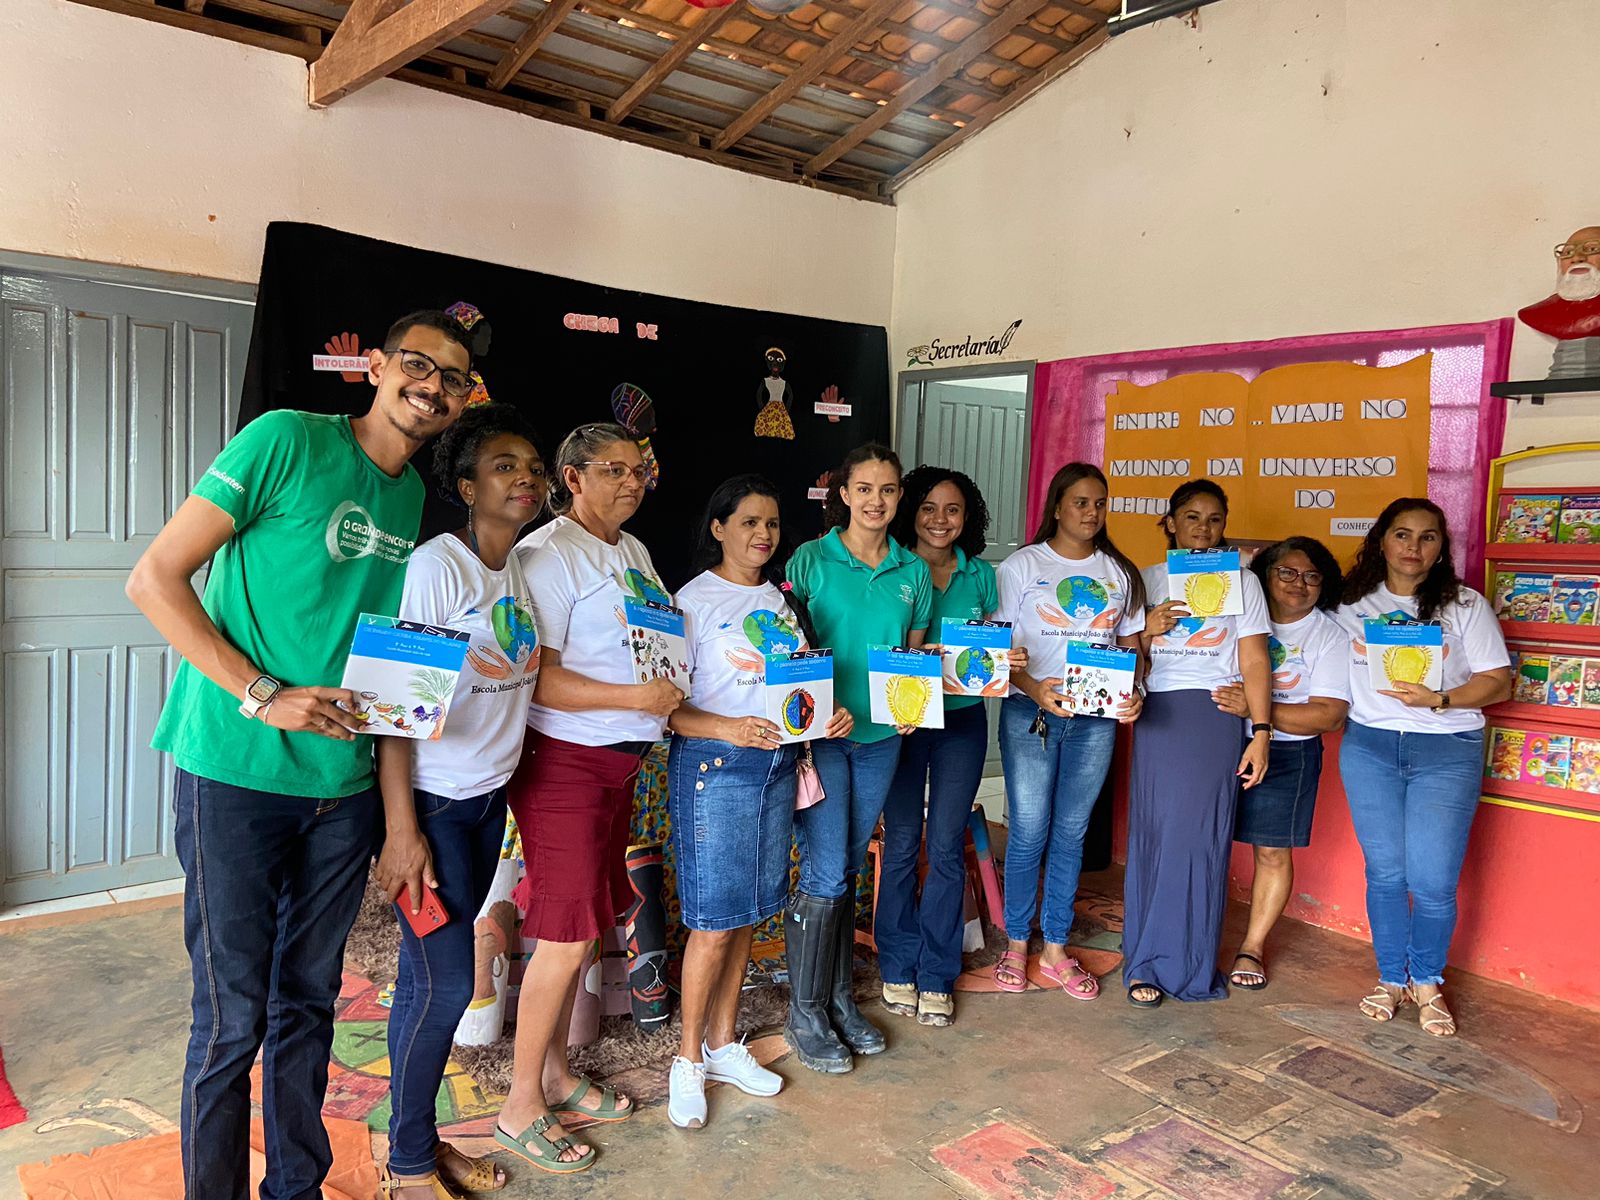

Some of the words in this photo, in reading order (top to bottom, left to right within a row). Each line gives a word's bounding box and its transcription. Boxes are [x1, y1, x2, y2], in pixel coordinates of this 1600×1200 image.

[563, 313, 620, 334] CHEGA
[636, 322, 659, 341] DE
[1115, 411, 1180, 431] ENTRE
[1202, 407, 1235, 426] NO
[1275, 402, 1344, 423] VIAJE
[1363, 398, 1407, 420] NO
[1110, 459, 1190, 477] MUNDO
[1210, 458, 1243, 477] DA
[1262, 456, 1395, 477] UNIVERSO
[1297, 489, 1335, 509] DO
[1060, 630, 1087, 638] Municipal
[1159, 648, 1184, 656] Municipal
[1184, 649, 1198, 657] João
[471, 684, 497, 694] Escola
[736, 676, 758, 687] Escola
